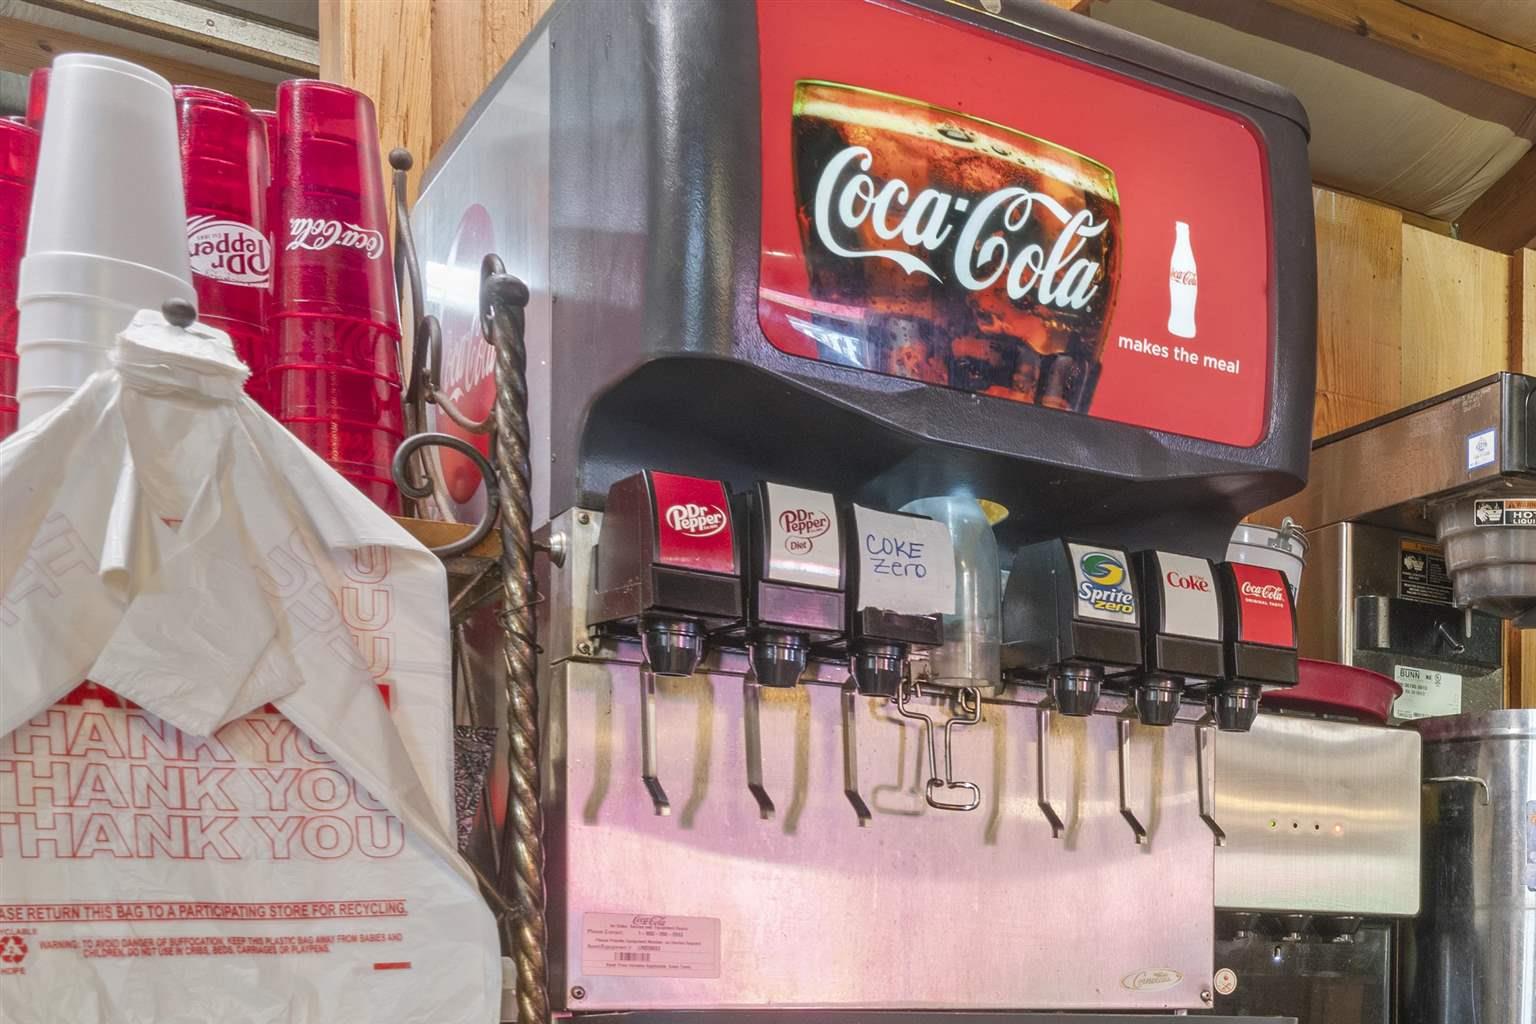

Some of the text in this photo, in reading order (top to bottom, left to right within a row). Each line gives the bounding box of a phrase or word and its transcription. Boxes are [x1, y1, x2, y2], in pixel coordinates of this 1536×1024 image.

[286, 218, 384, 259] Coca-Cola
[815, 146, 1109, 310] Coca-Cola
[1118, 336, 1240, 374] makes the meal
[673, 505, 722, 532] Pepper
[687, 504, 708, 517] Dr
[798, 510, 814, 521] Dr
[785, 511, 826, 533] Pepper
[790, 541, 807, 551] Diet
[866, 534, 925, 558] COKE
[1167, 571, 1209, 592] Coke
[1241, 581, 1285, 601] Coca-Cola
[1079, 582, 1133, 605] Sprite
[1094, 600, 1133, 614] zero
[252, 815, 405, 860] YOU
[27, 902, 408, 920] RETURN THIS BAG TO A PARTICIPATING STORE FOR RECYCLING.
[82, 939, 93, 948] TO
[122, 938, 154, 947] DANGER
[266, 936, 295, 945] PLASTIC
